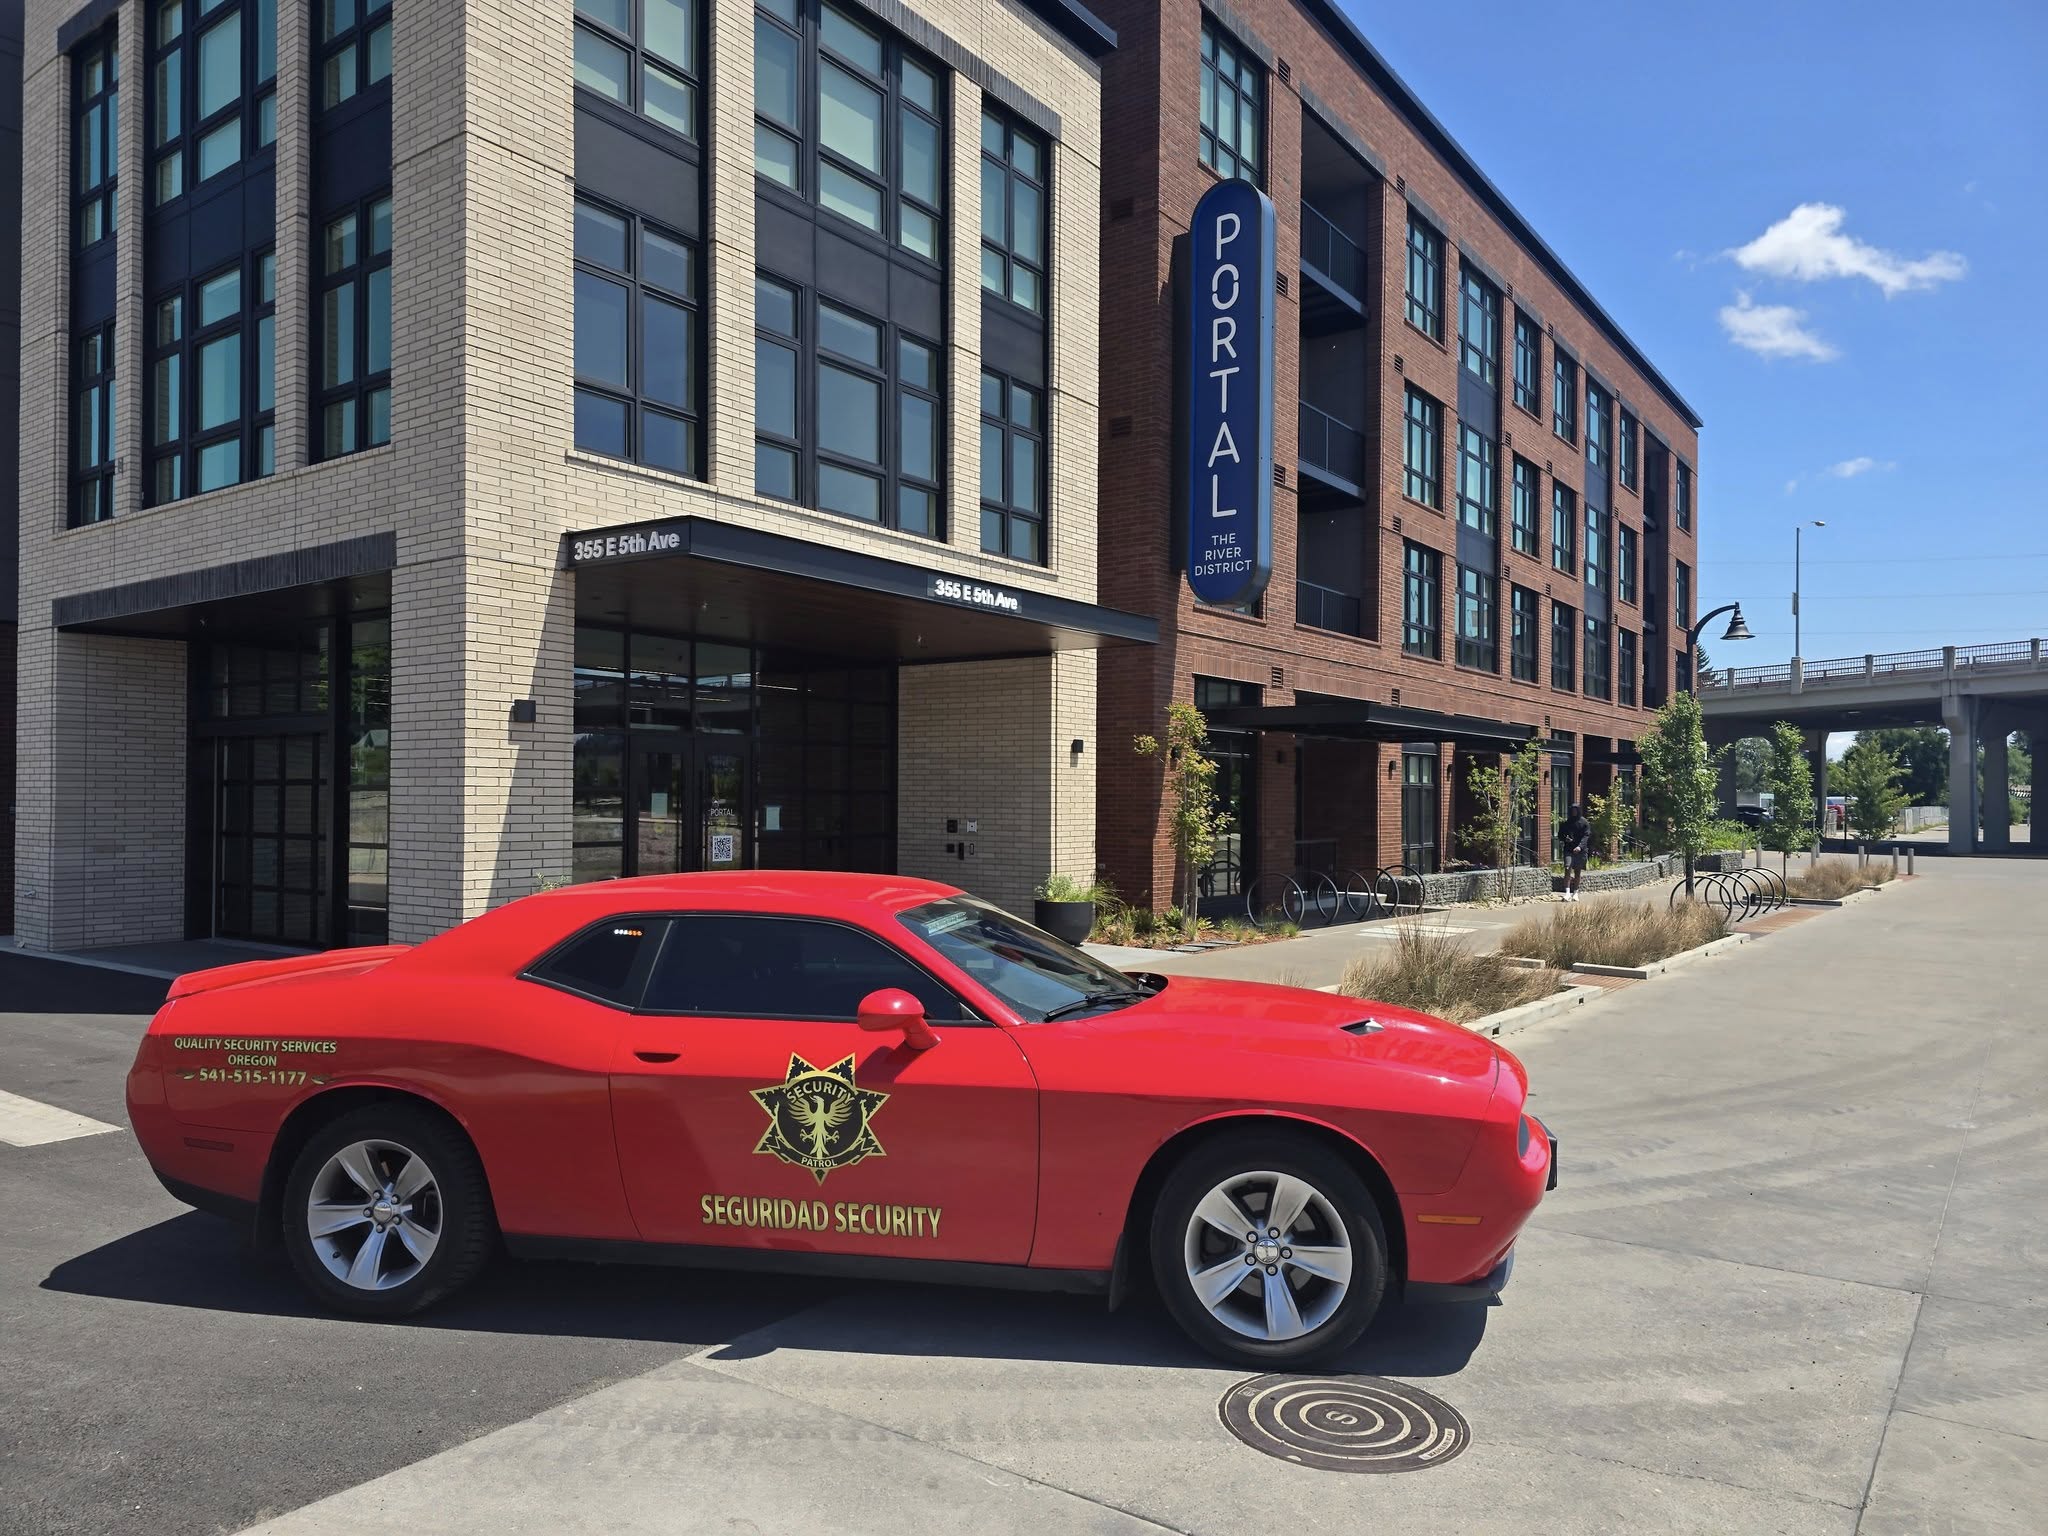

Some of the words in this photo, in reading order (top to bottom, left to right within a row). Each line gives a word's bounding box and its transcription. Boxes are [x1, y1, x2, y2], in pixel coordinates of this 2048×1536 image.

[1208, 212, 1241, 518] PORTAL
[574, 539, 604, 560] 355
[606, 537, 617, 556] E
[618, 533, 647, 555] 5th
[648, 531, 680, 551] Ave
[1211, 532, 1236, 546] THE
[1205, 546, 1242, 560] RIVER
[1195, 559, 1252, 576] DISTRICT
[935, 579, 961, 599] 355
[962, 585, 972, 601] E
[973, 587, 994, 606] 5th
[995, 592, 1018, 610] Ave
[711, 808, 735, 817] PORTAL
[174, 1037, 222, 1050] QUALITY
[223, 1039, 279, 1052] SECURITY
[281, 1040, 337, 1054] SERVICES
[227, 1054, 277, 1067] OREGON
[199, 1068, 307, 1085] 541-515-1177
[786, 1081, 855, 1105] SECURITY
[801, 1156, 838, 1168] PATROL
[700, 1193, 830, 1232] SEGURIDAD
[833, 1201, 942, 1239] SECURITY
[1326, 1411, 1358, 1425] S
